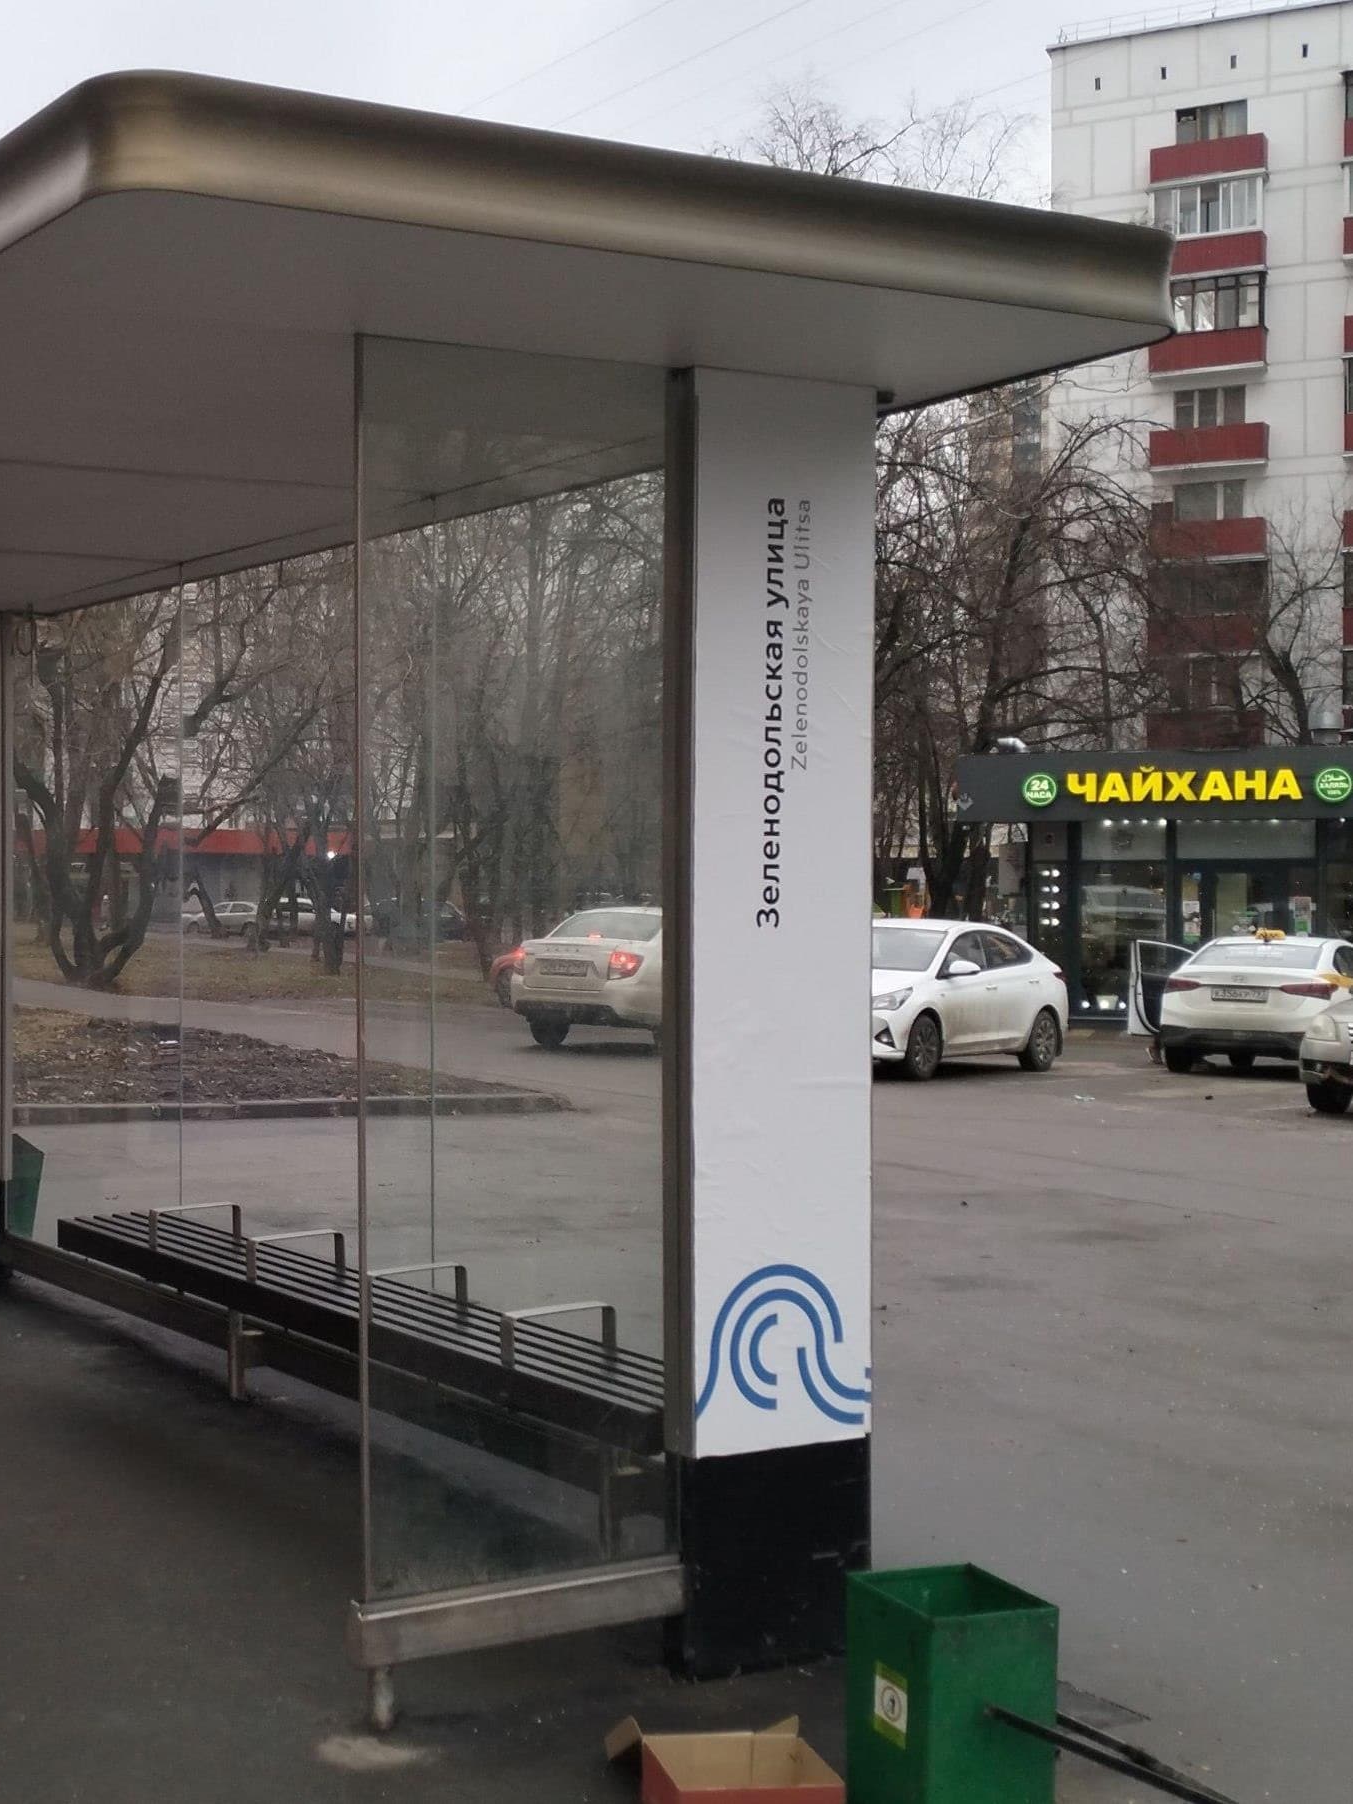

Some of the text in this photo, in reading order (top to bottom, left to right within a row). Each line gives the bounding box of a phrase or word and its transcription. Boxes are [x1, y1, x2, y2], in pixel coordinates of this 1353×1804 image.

[790, 500, 813, 771] Zelenodolskaya Ulitsa
[756, 497, 789, 928] Зеленодольская улица
[1027, 791, 1052, 799] ЧАСА
[1030, 779, 1049, 791] 24
[1066, 765, 1303, 803] ЧАЙХАНА
